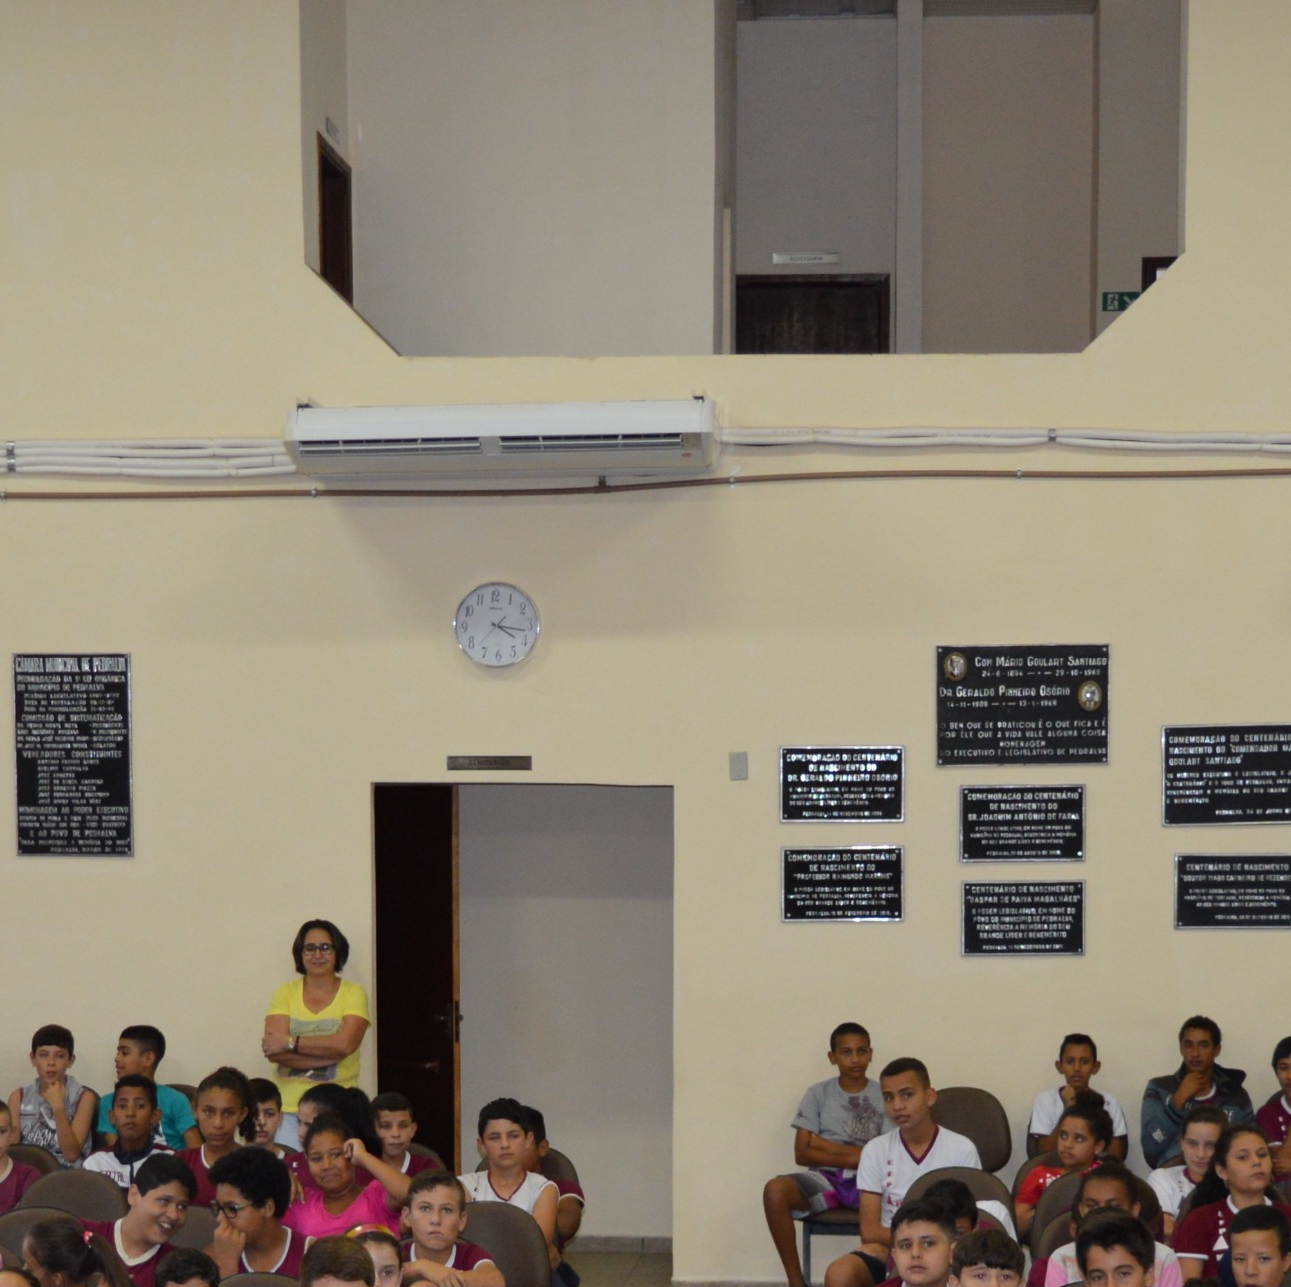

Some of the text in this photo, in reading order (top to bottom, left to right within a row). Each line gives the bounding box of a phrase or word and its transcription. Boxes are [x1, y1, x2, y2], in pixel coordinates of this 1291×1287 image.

[477, 593, 484, 606] 11
[492, 589, 500, 603] 12
[508, 593, 513, 605] 1
[465, 604, 474, 618] 10
[519, 602, 527, 615] 2
[461, 621, 468, 633] 9
[528, 617, 533, 631] 3
[468, 635, 475, 649] 8
[521, 634, 528, 647] 4
[481, 646, 487, 658] 7
[495, 649, 502, 662] 6
[511, 645, 517, 658] 5
[1081, 729, 1106, 737] COISA
